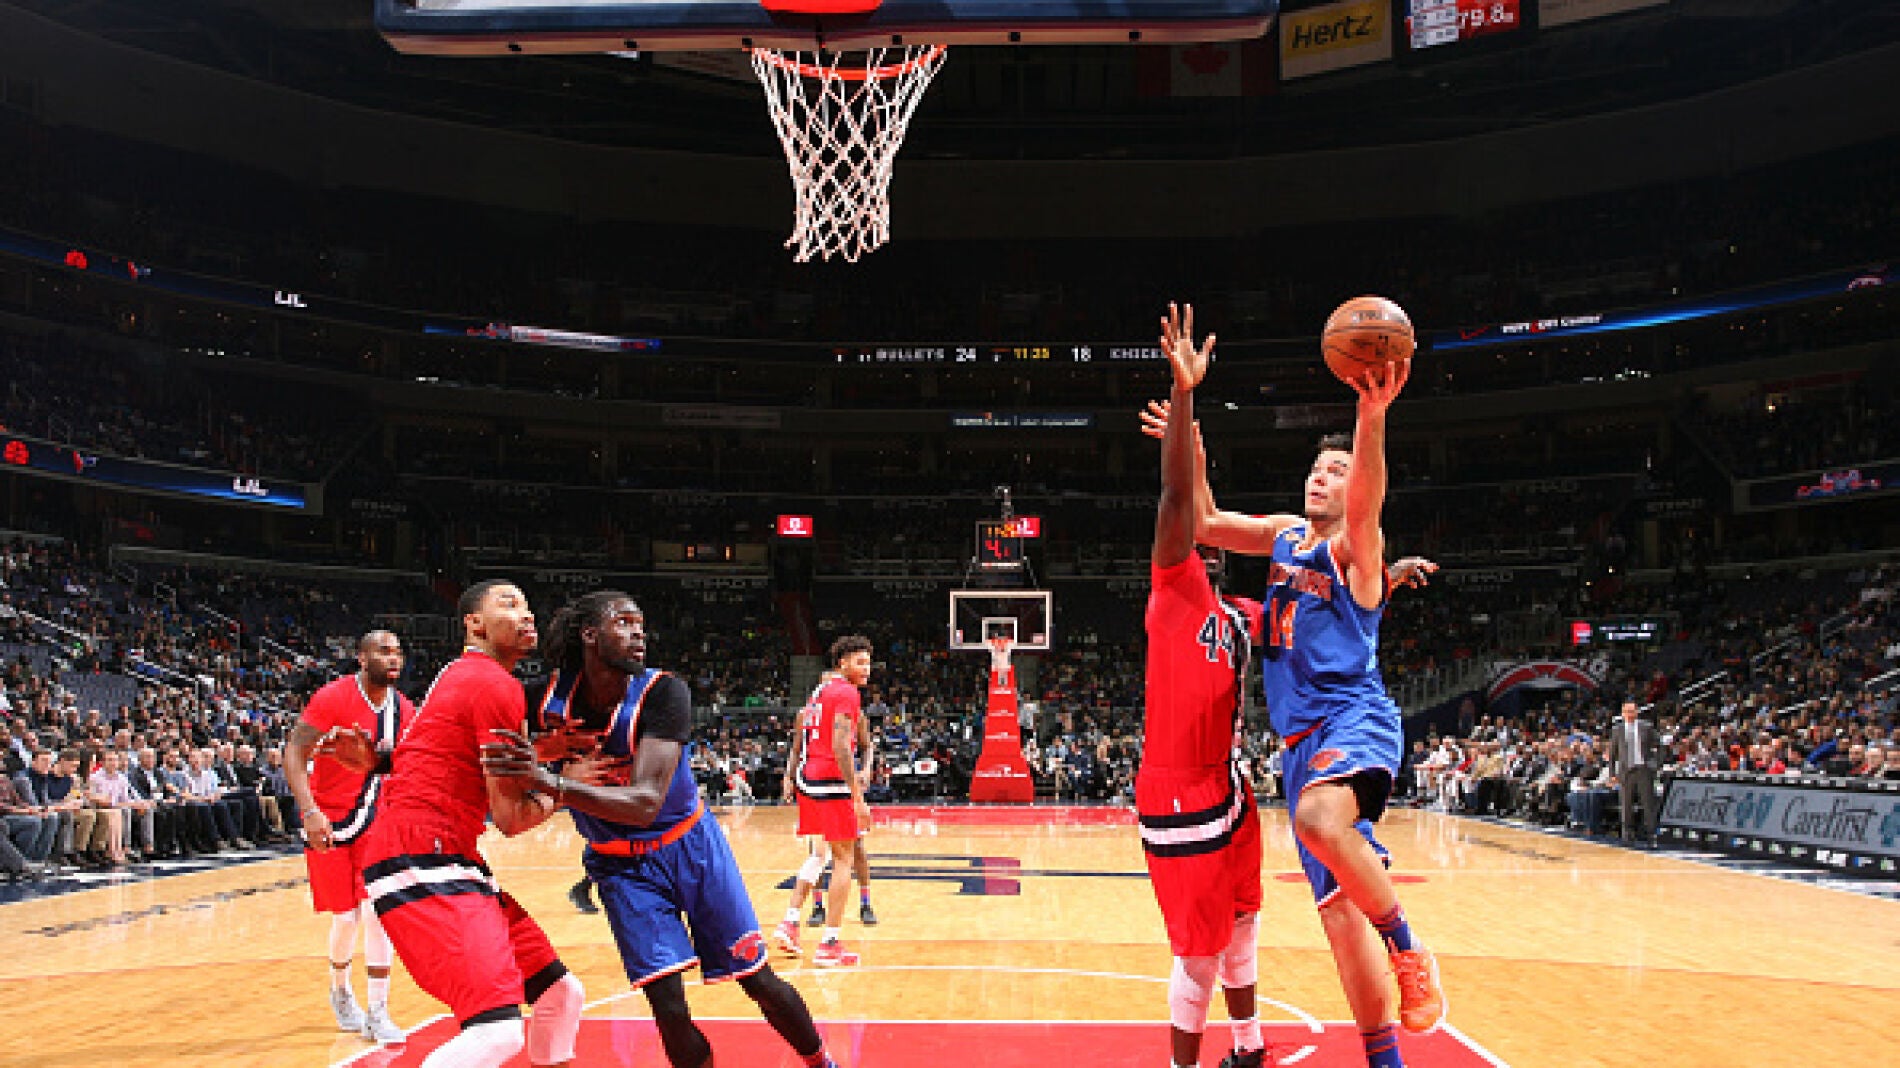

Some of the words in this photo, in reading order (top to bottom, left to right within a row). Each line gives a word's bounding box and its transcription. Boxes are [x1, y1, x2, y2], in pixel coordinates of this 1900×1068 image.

[1292, 14, 1373, 48] Hertz
[875, 347, 945, 361] BULLETS
[955, 346, 976, 362] 24
[1071, 345, 1092, 362] 18
[1196, 611, 1236, 669] 44
[1666, 785, 1738, 826] CareFirst
[1780, 795, 1879, 845] CareFirst
